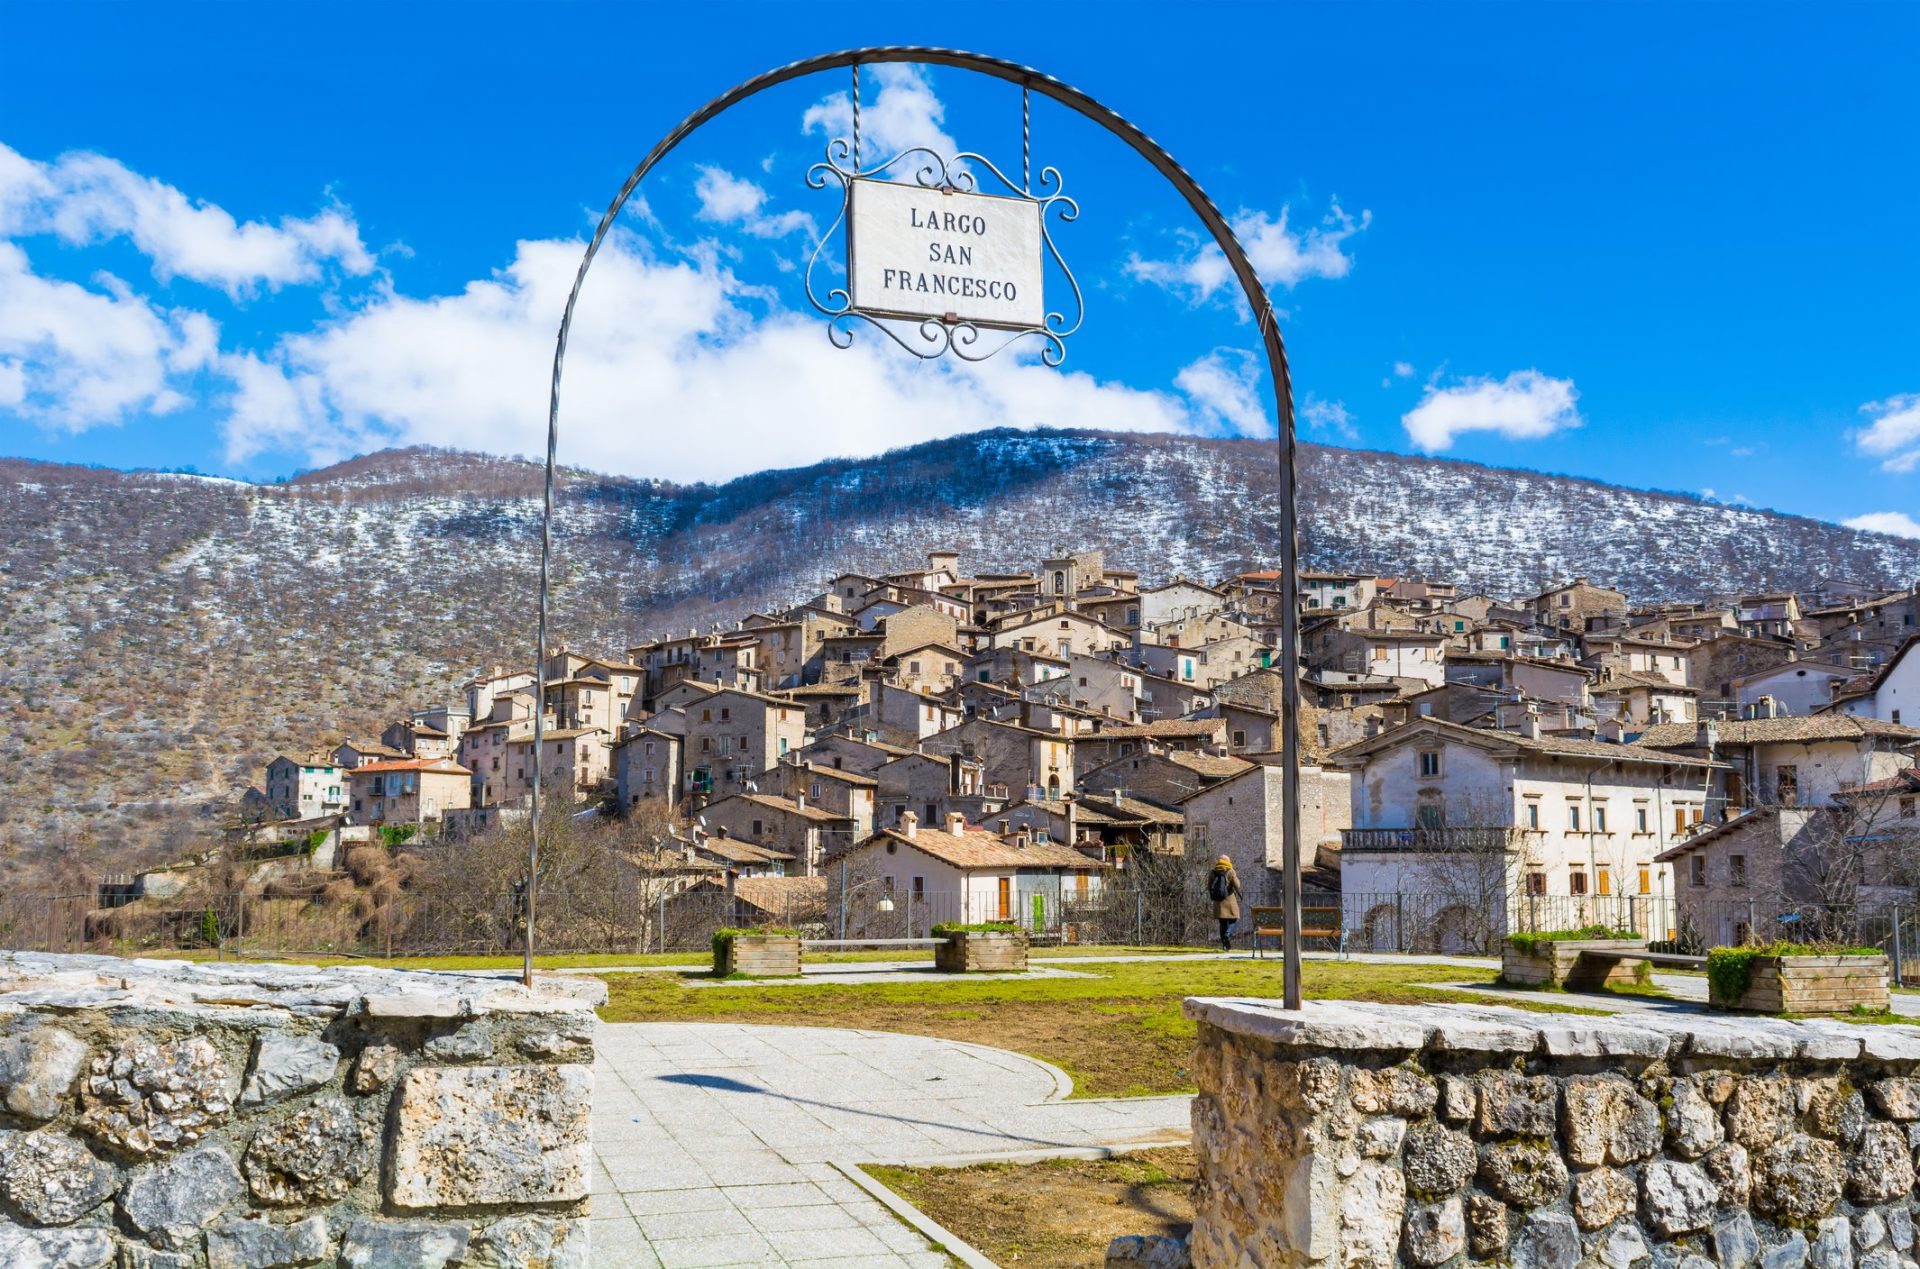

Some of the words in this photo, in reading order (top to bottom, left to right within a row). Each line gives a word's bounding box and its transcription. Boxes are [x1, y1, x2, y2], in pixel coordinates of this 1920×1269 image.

[911, 207, 986, 236] LARGO
[929, 242, 972, 266] SAN
[883, 268, 1017, 301] FRANCESCO
